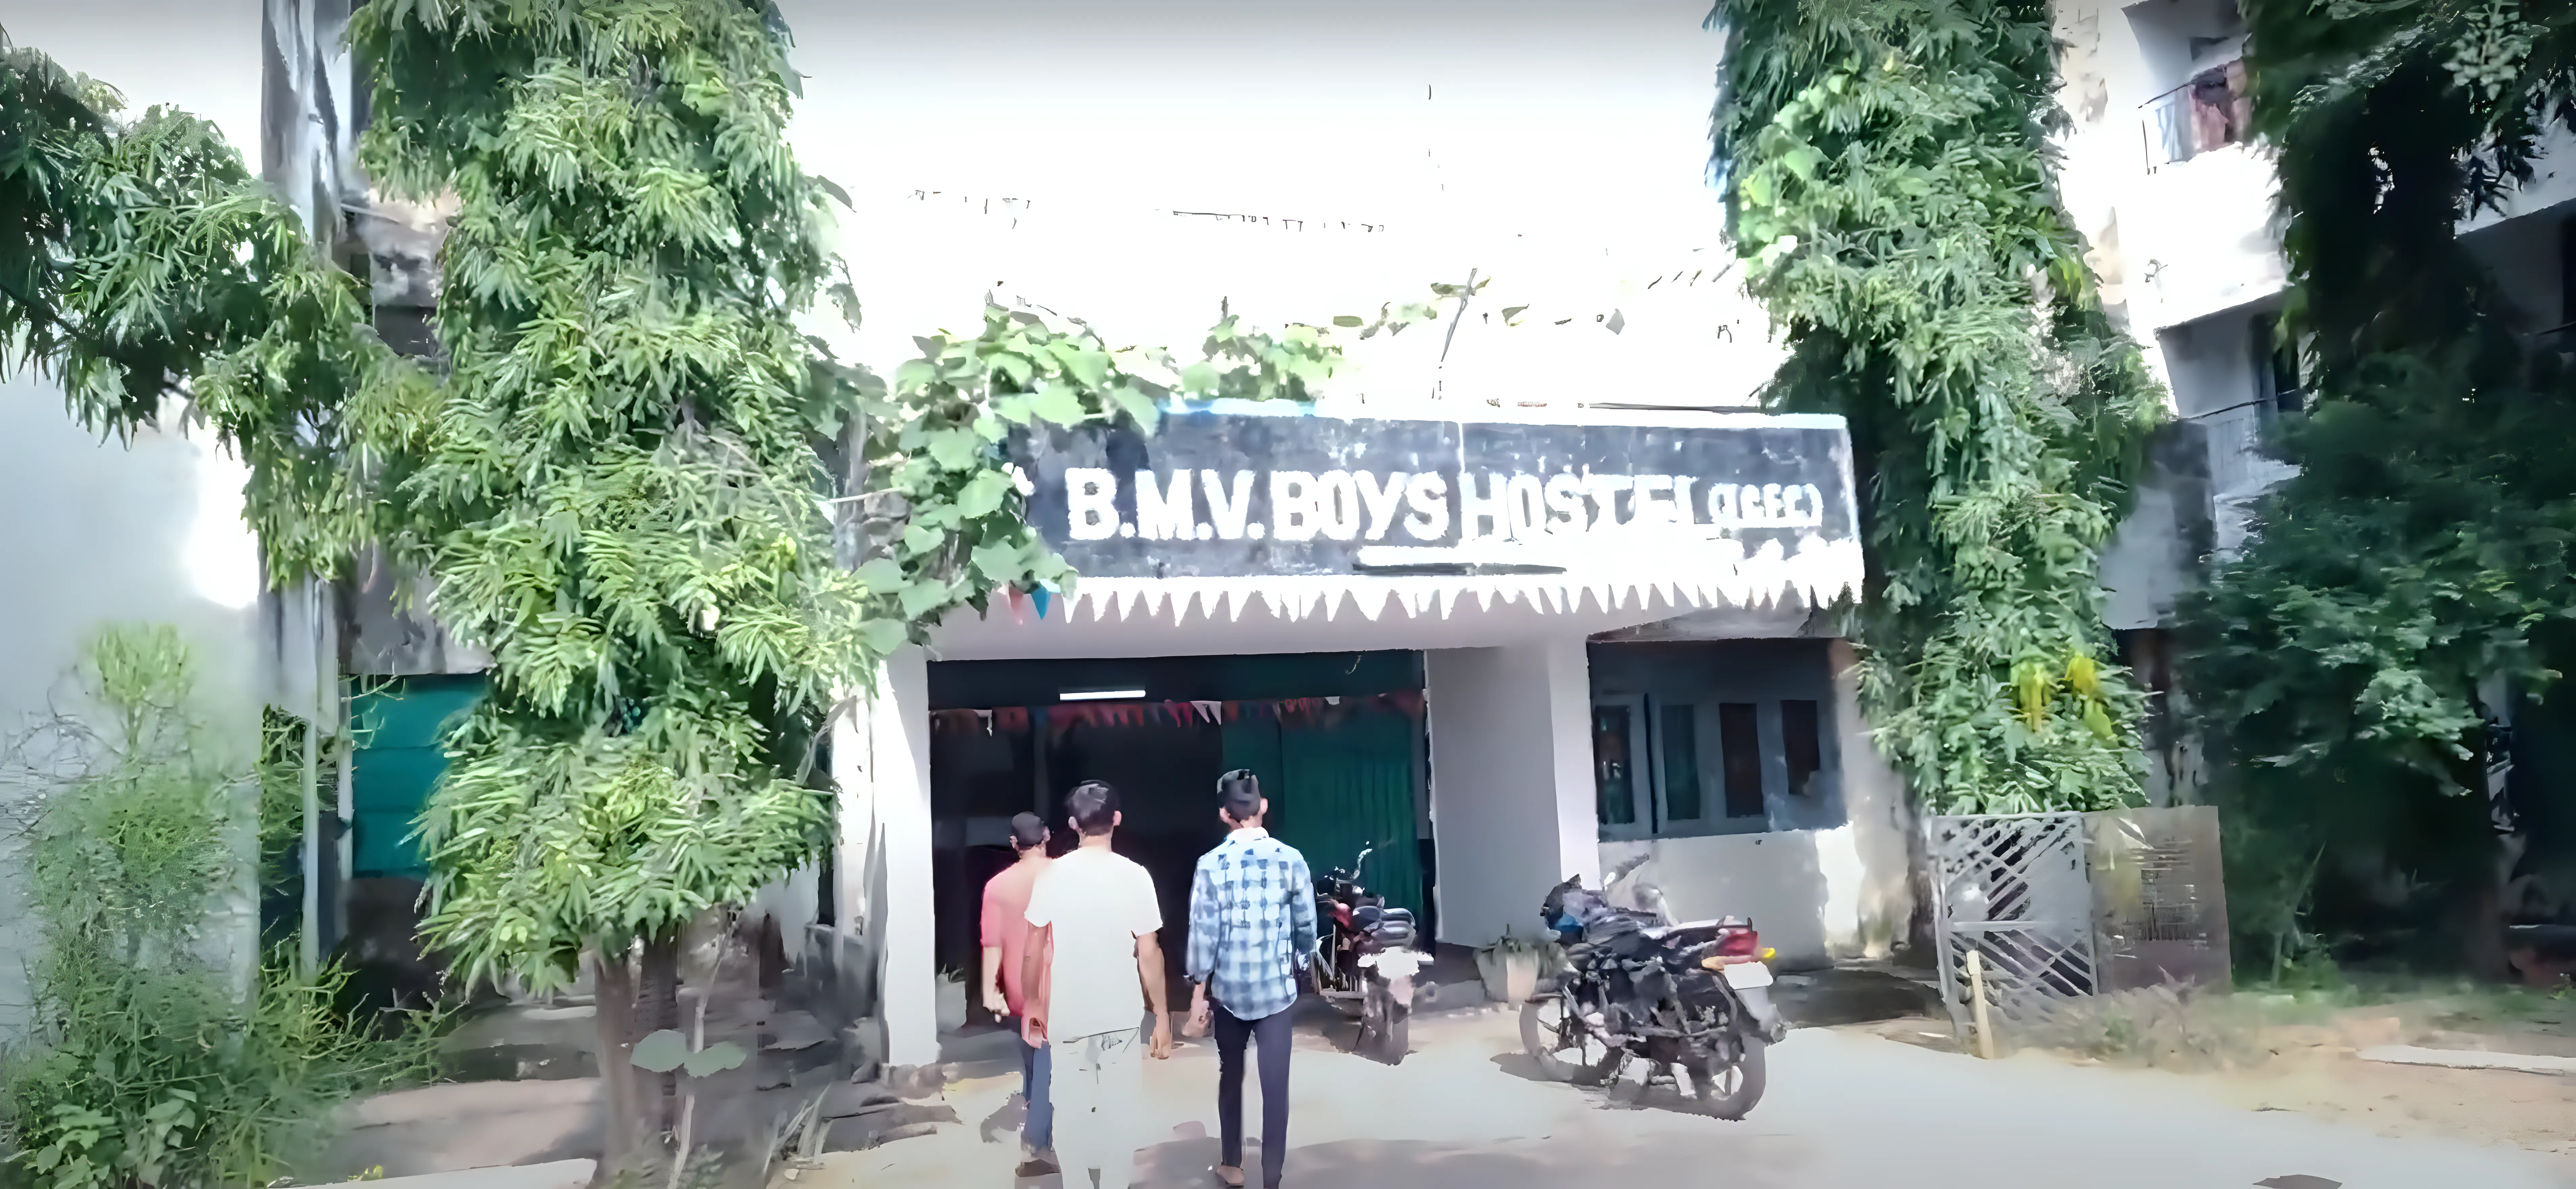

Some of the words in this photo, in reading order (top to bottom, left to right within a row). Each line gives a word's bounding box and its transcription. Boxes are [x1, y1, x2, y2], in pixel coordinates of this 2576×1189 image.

[1065, 467, 1266, 541] B.M.V.
[1270, 469, 1450, 541] BOYS
[1459, 471, 1702, 542] HOSTEL
